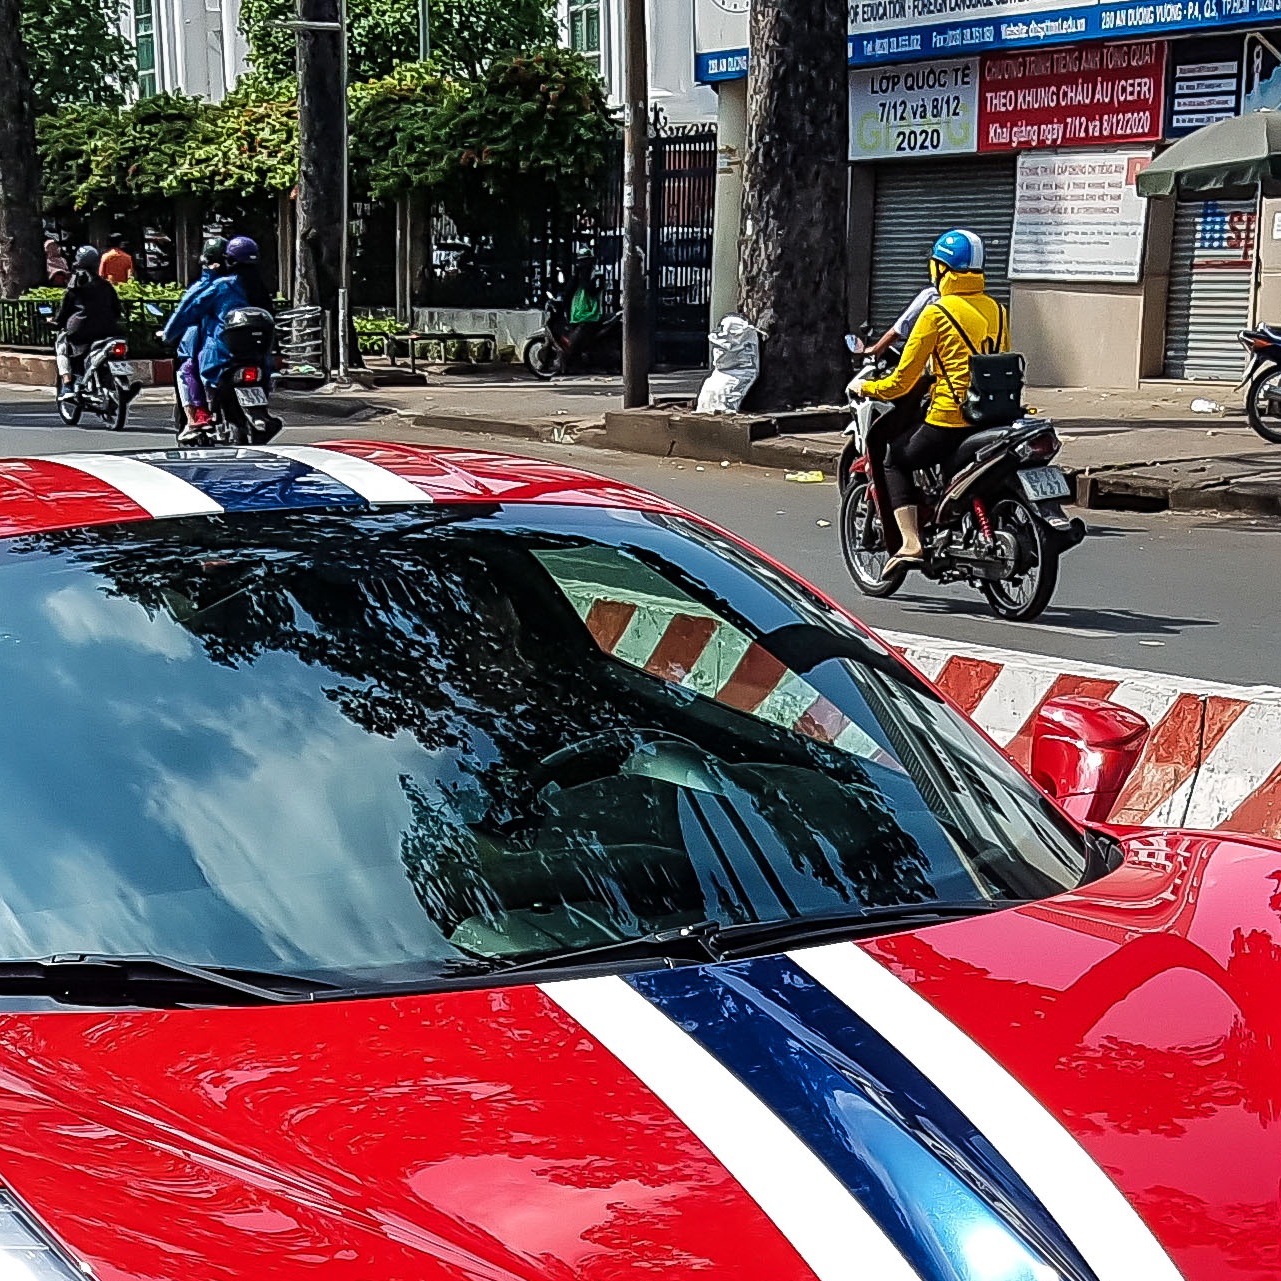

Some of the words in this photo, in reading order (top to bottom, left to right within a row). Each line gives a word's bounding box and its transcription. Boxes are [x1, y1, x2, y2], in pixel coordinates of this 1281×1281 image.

[879, 99, 907, 123] 7/12
[911, 97, 927, 119] và
[931, 95, 960, 118] 8/12
[986, 90, 1015, 112] THEO
[1017, 85, 1057, 109] KHUNG
[1114, 77, 1155, 108] (CEFR)
[896, 128, 941, 151] 2020
[988, 121, 1010, 144] Khai
[1066, 117, 1087, 139] 7/12
[1102, 110, 1151, 137] 8/12/2020
